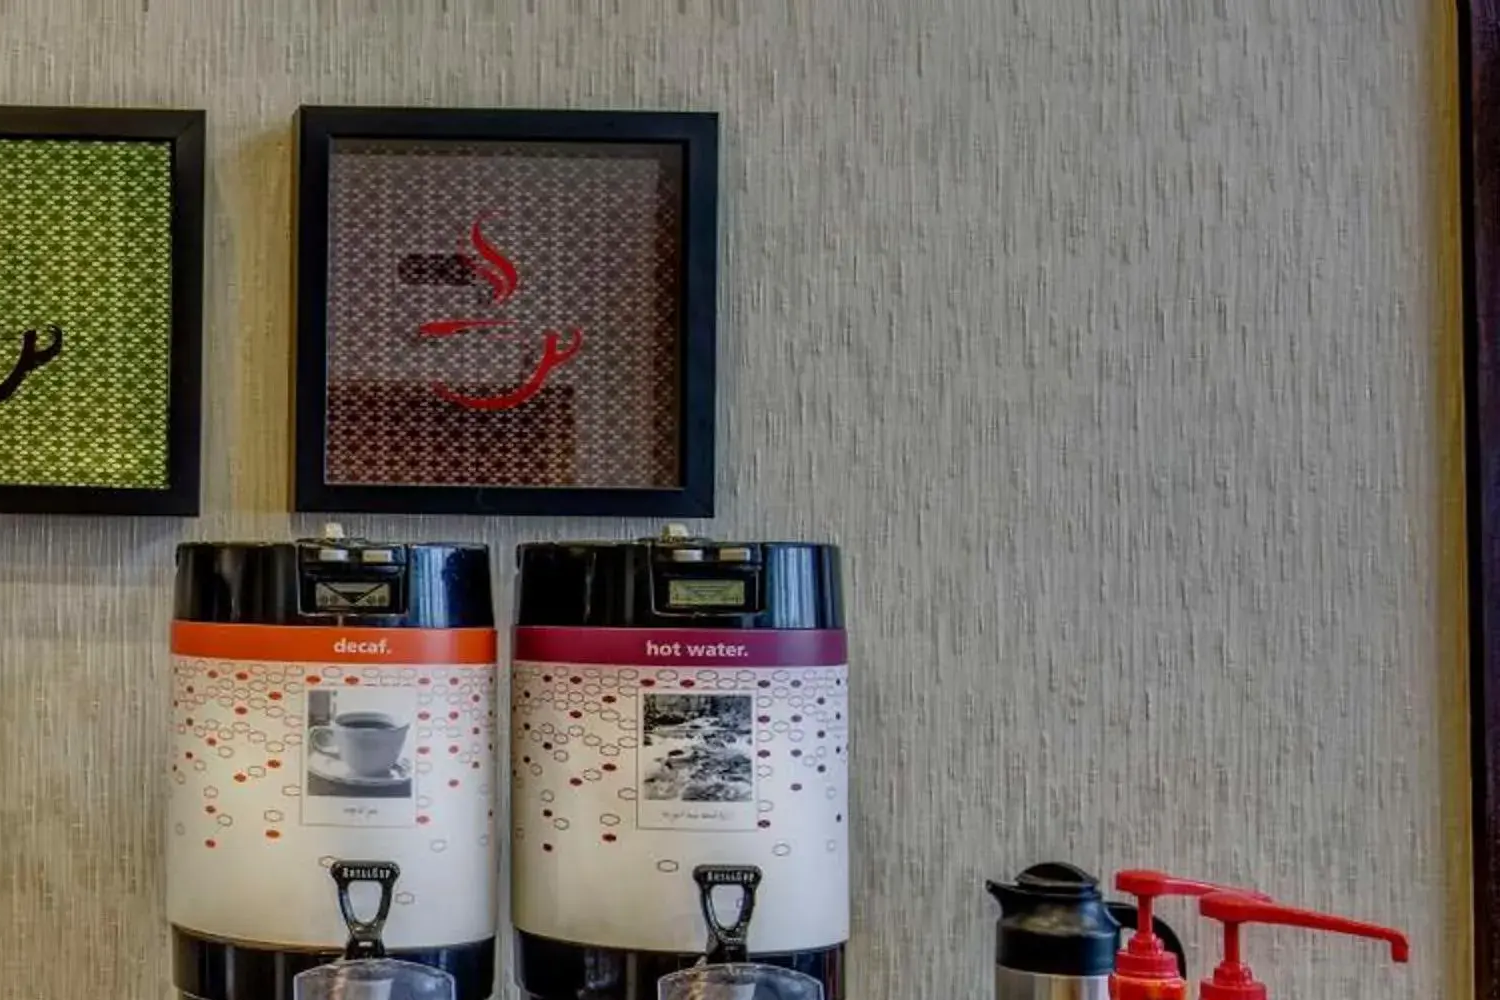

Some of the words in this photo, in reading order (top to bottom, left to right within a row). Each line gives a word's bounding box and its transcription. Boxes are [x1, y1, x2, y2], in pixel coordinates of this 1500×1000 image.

[333, 637, 392, 655] decaf.
[646, 640, 681, 657] hot
[686, 642, 748, 657] water.
